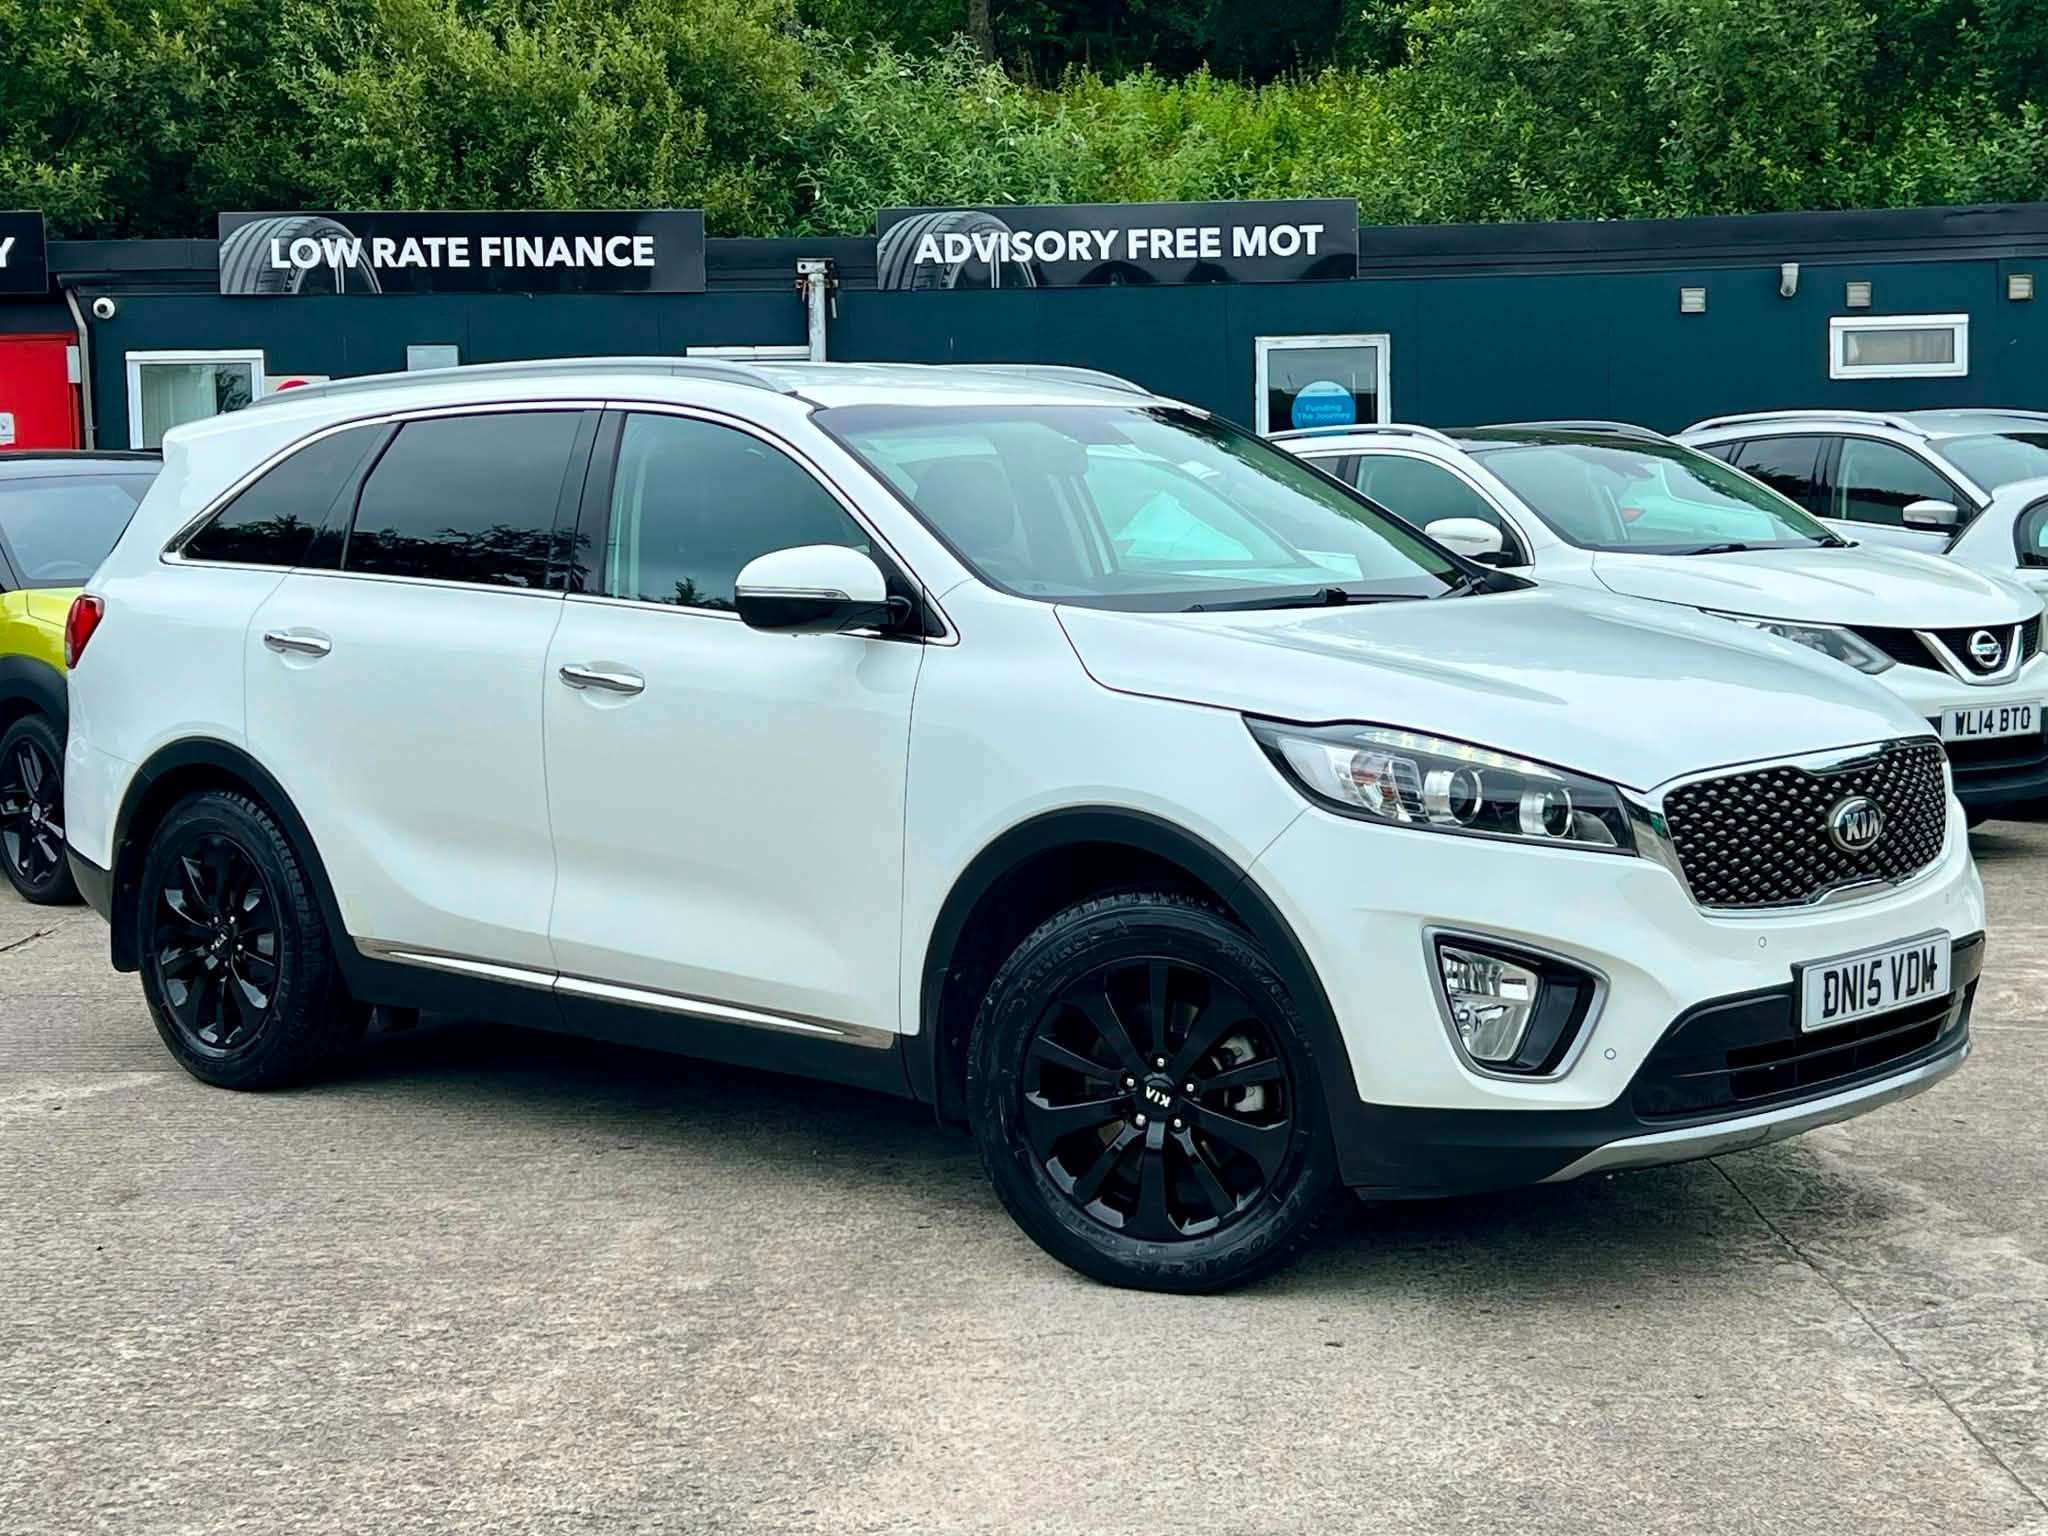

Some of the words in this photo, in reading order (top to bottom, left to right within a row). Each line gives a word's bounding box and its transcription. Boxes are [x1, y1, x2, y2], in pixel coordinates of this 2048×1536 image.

[271, 237, 362, 268] LOW
[372, 237, 470, 268] RATE
[480, 236, 655, 267] FINANCE
[914, 231, 1117, 264] ADVISORY
[1127, 228, 1222, 259] FREE
[1232, 225, 1324, 257] MOT
[1955, 709, 1994, 736] WL14
[2000, 706, 2031, 732] BTO
[1844, 811, 1880, 841] KIA
[1822, 960, 1882, 1018] DN15
[1145, 1085, 1171, 1108] KIA
